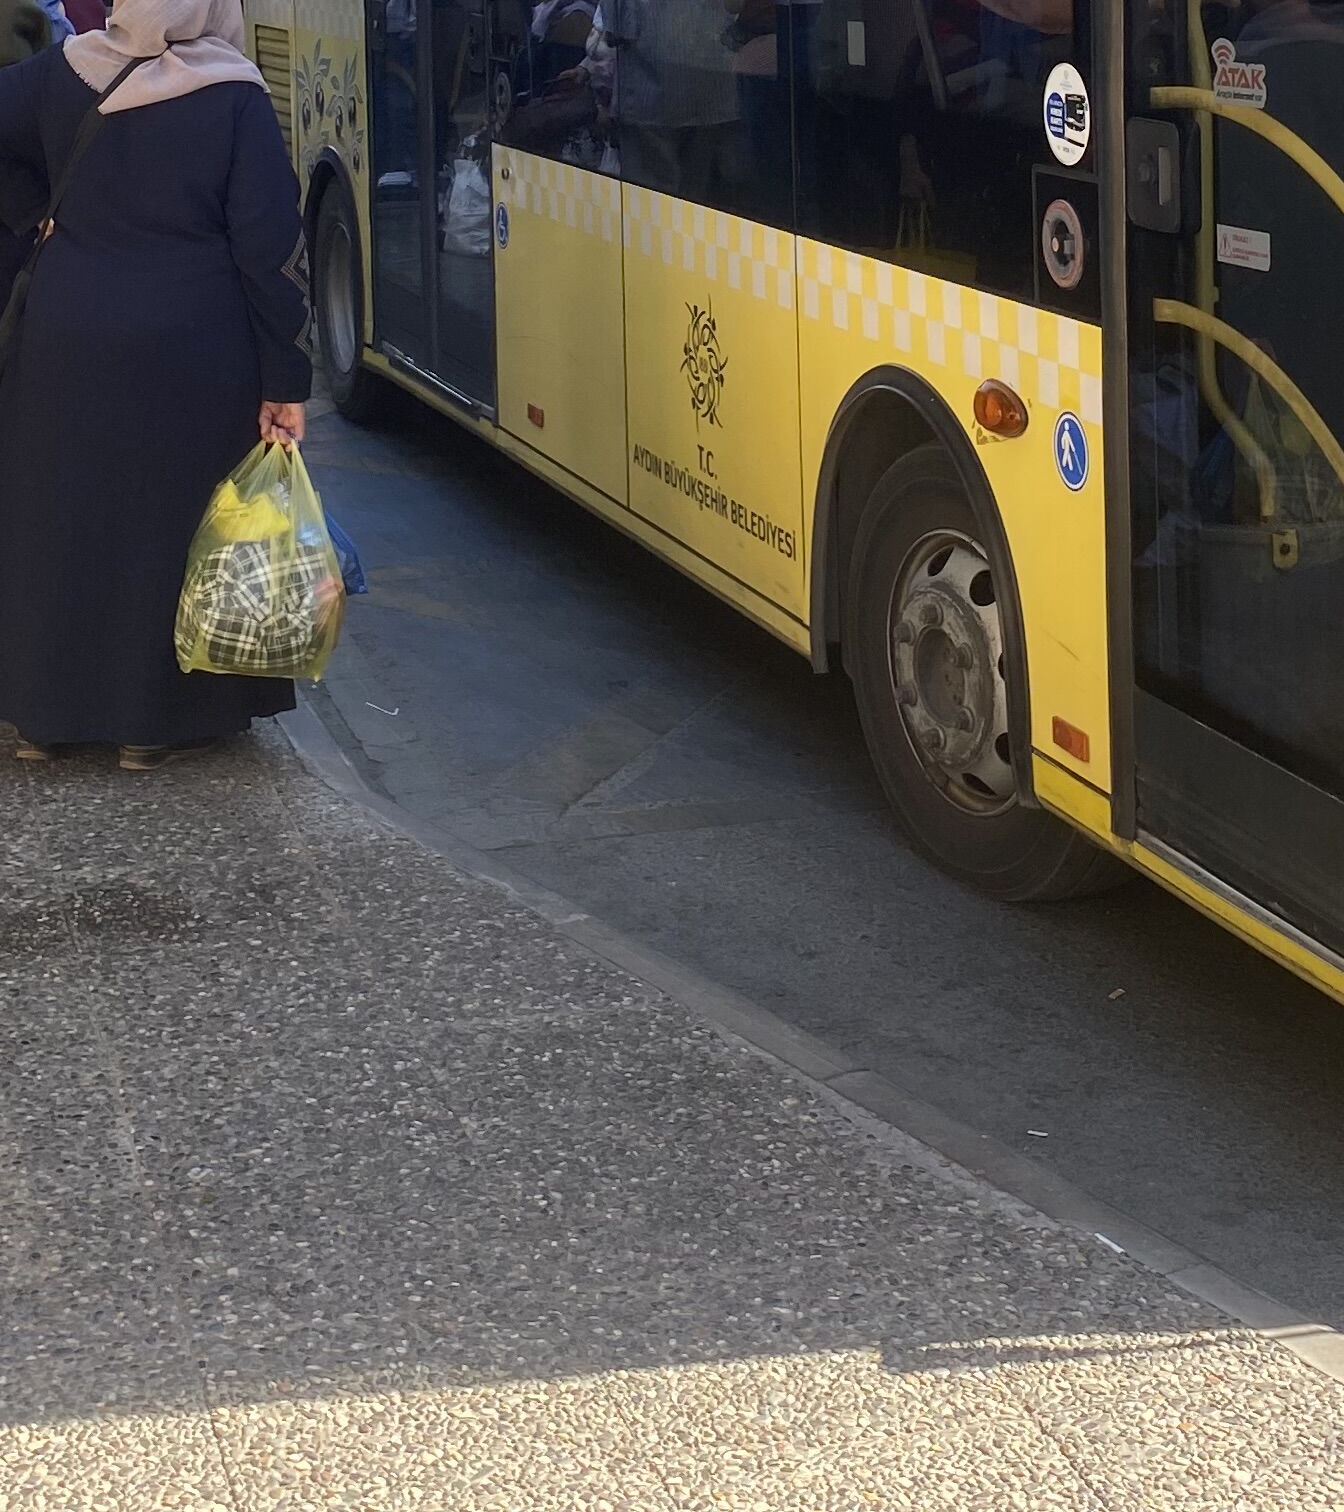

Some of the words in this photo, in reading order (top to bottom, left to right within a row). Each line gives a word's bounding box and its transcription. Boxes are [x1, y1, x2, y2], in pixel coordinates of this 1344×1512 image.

[1216, 67, 1264, 90] ATAK
[697, 444, 718, 481] T.C.
[633, 443, 663, 480] AYDIN
[664, 459, 729, 521] BÜYÜKŞEHİR
[730, 499, 797, 562] BELEDİYESİ
